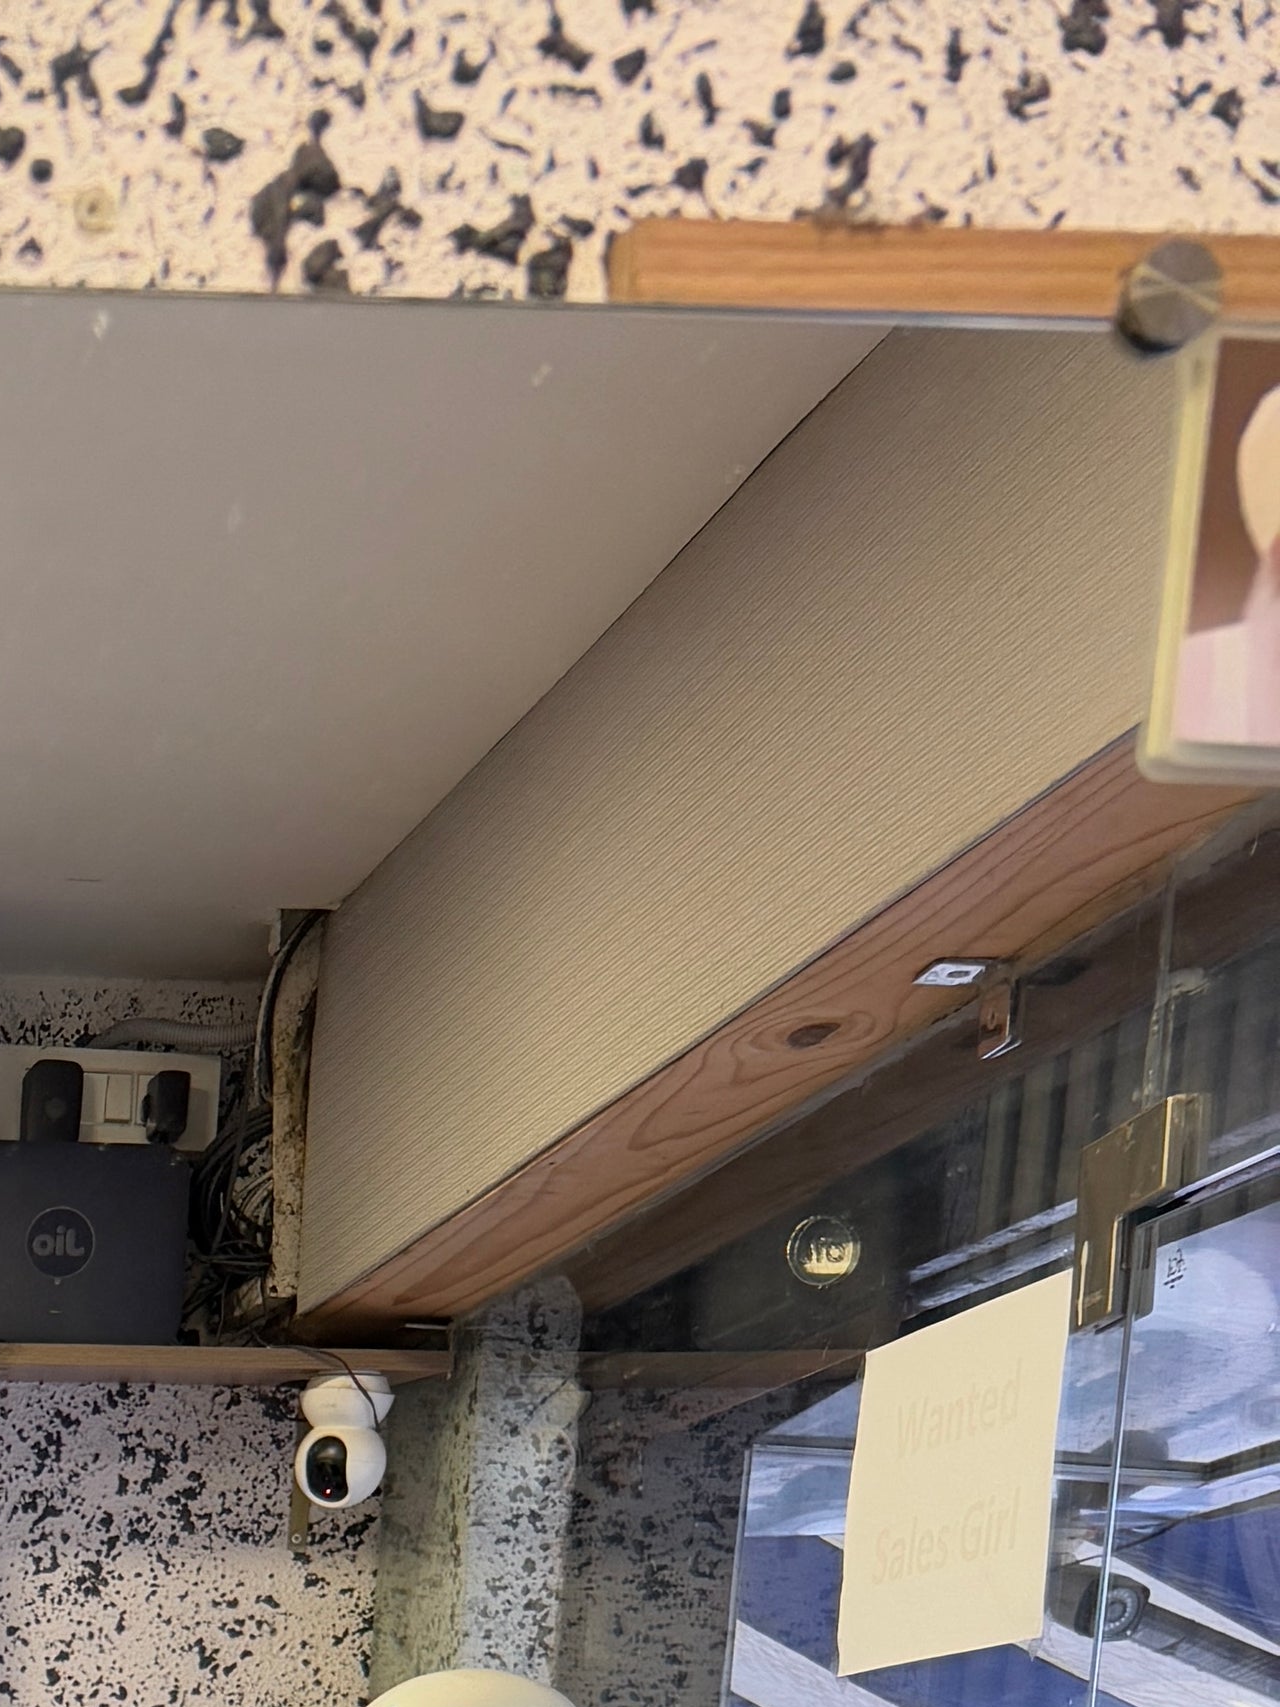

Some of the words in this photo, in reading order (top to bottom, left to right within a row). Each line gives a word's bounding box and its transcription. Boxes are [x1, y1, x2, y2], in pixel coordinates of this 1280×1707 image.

[894, 1358, 1023, 1462] Wanted
[872, 1515, 949, 1586] Sales
[959, 1487, 1020, 1562] Girl
